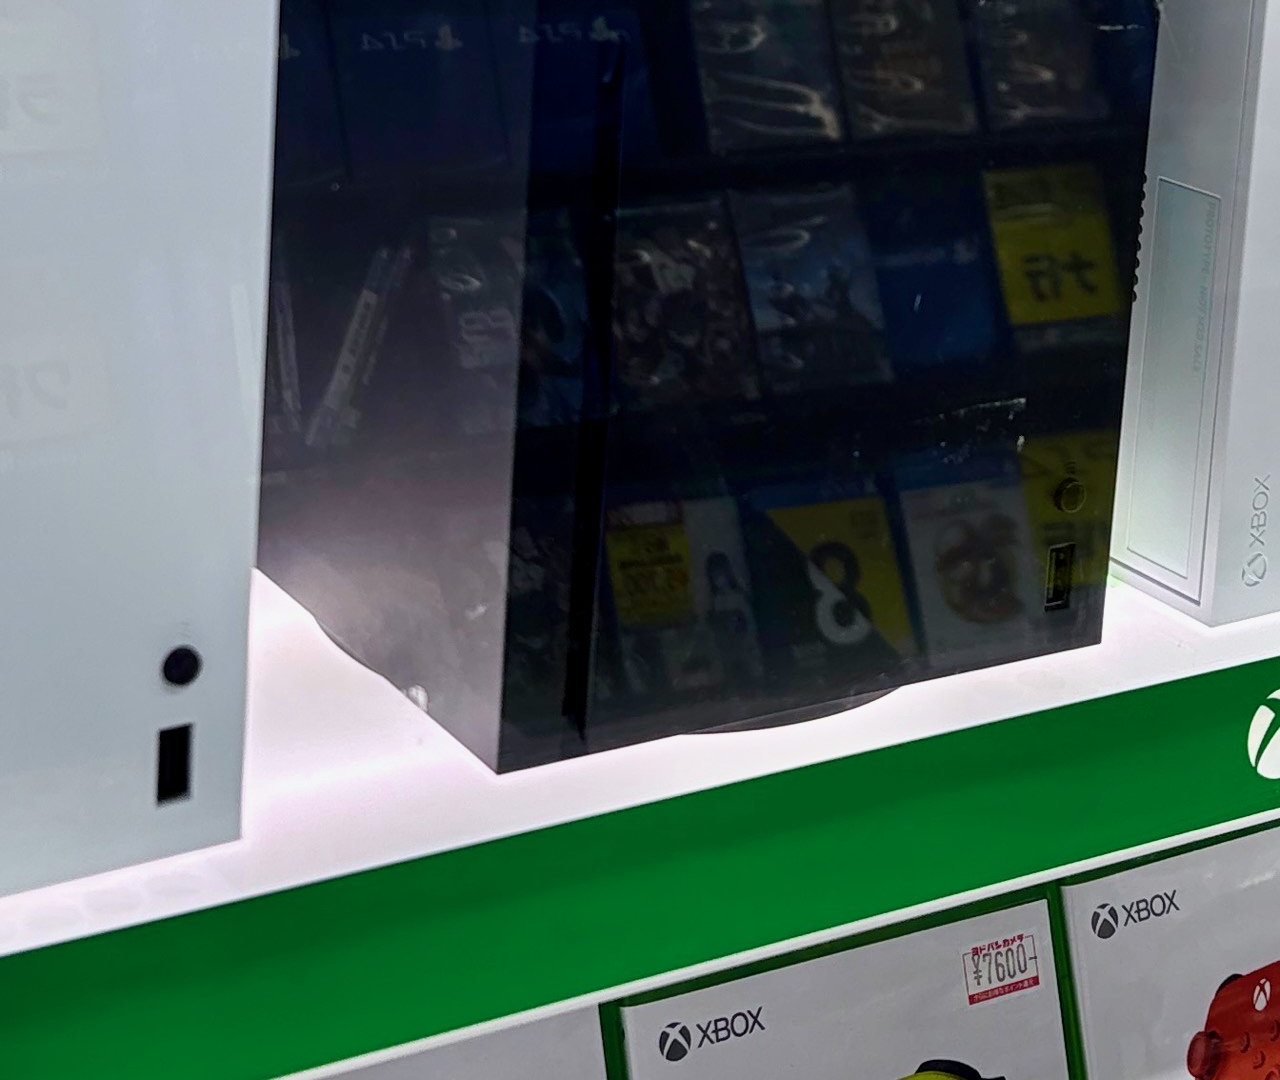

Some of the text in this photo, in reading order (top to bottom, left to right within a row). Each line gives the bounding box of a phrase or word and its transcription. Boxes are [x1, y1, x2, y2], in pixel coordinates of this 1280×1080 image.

[1248, 474, 1271, 547] XBOX
[1122, 889, 1180, 929] XBOX
[970, 933, 1025, 956] ヨドバシカメラ
[971, 942, 1037, 987] ¥7600-
[697, 1006, 766, 1049] XBOX
